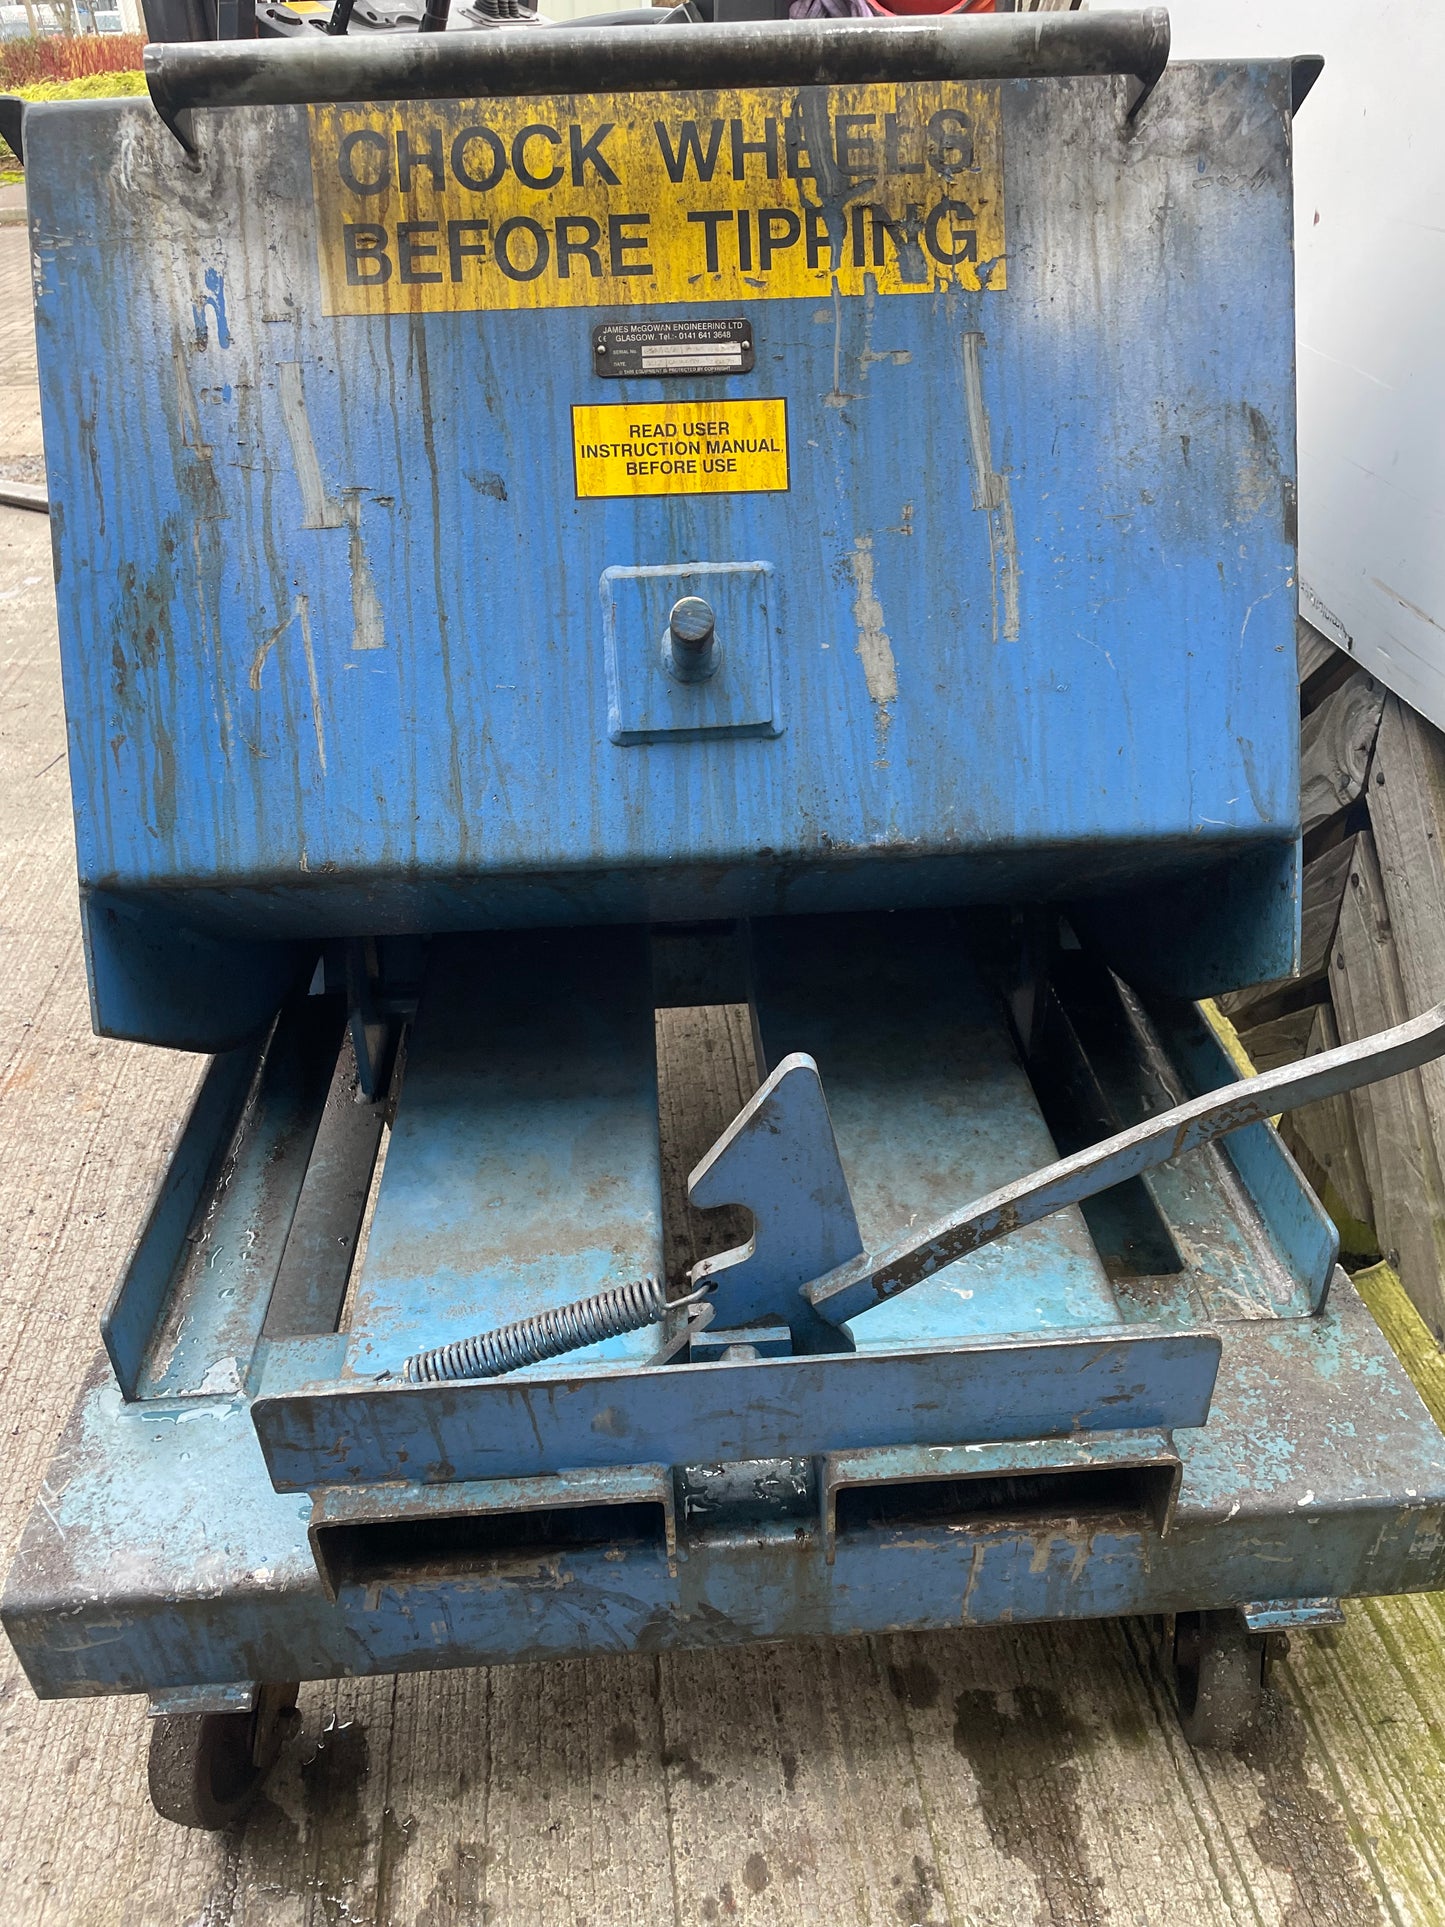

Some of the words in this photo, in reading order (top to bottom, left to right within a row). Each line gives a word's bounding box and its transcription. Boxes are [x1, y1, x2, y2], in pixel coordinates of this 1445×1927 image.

[338, 122, 622, 196] CHOCK
[653, 108, 974, 184] WHEELS
[343, 212, 654, 287] BEFORE
[687, 200, 979, 275] TIPPING
[603, 325, 629, 334] JAMES
[630, 324, 671, 333] McGOWAN
[673, 322, 727, 332] ENGINEERING
[728, 321, 743, 330] LTD
[615, 334, 657, 343] GLASGOW.
[678, 332, 696, 340] 0141
[698, 331, 711, 339] 641
[713, 330, 732, 339] 3648
[629, 424, 677, 438] READ
[683, 421, 730, 437] USER
[581, 442, 701, 459] INSTRUCTION
[706, 438, 780, 455] MANUAL
[626, 460, 697, 476] BEFORE
[703, 458, 737, 473] USE
